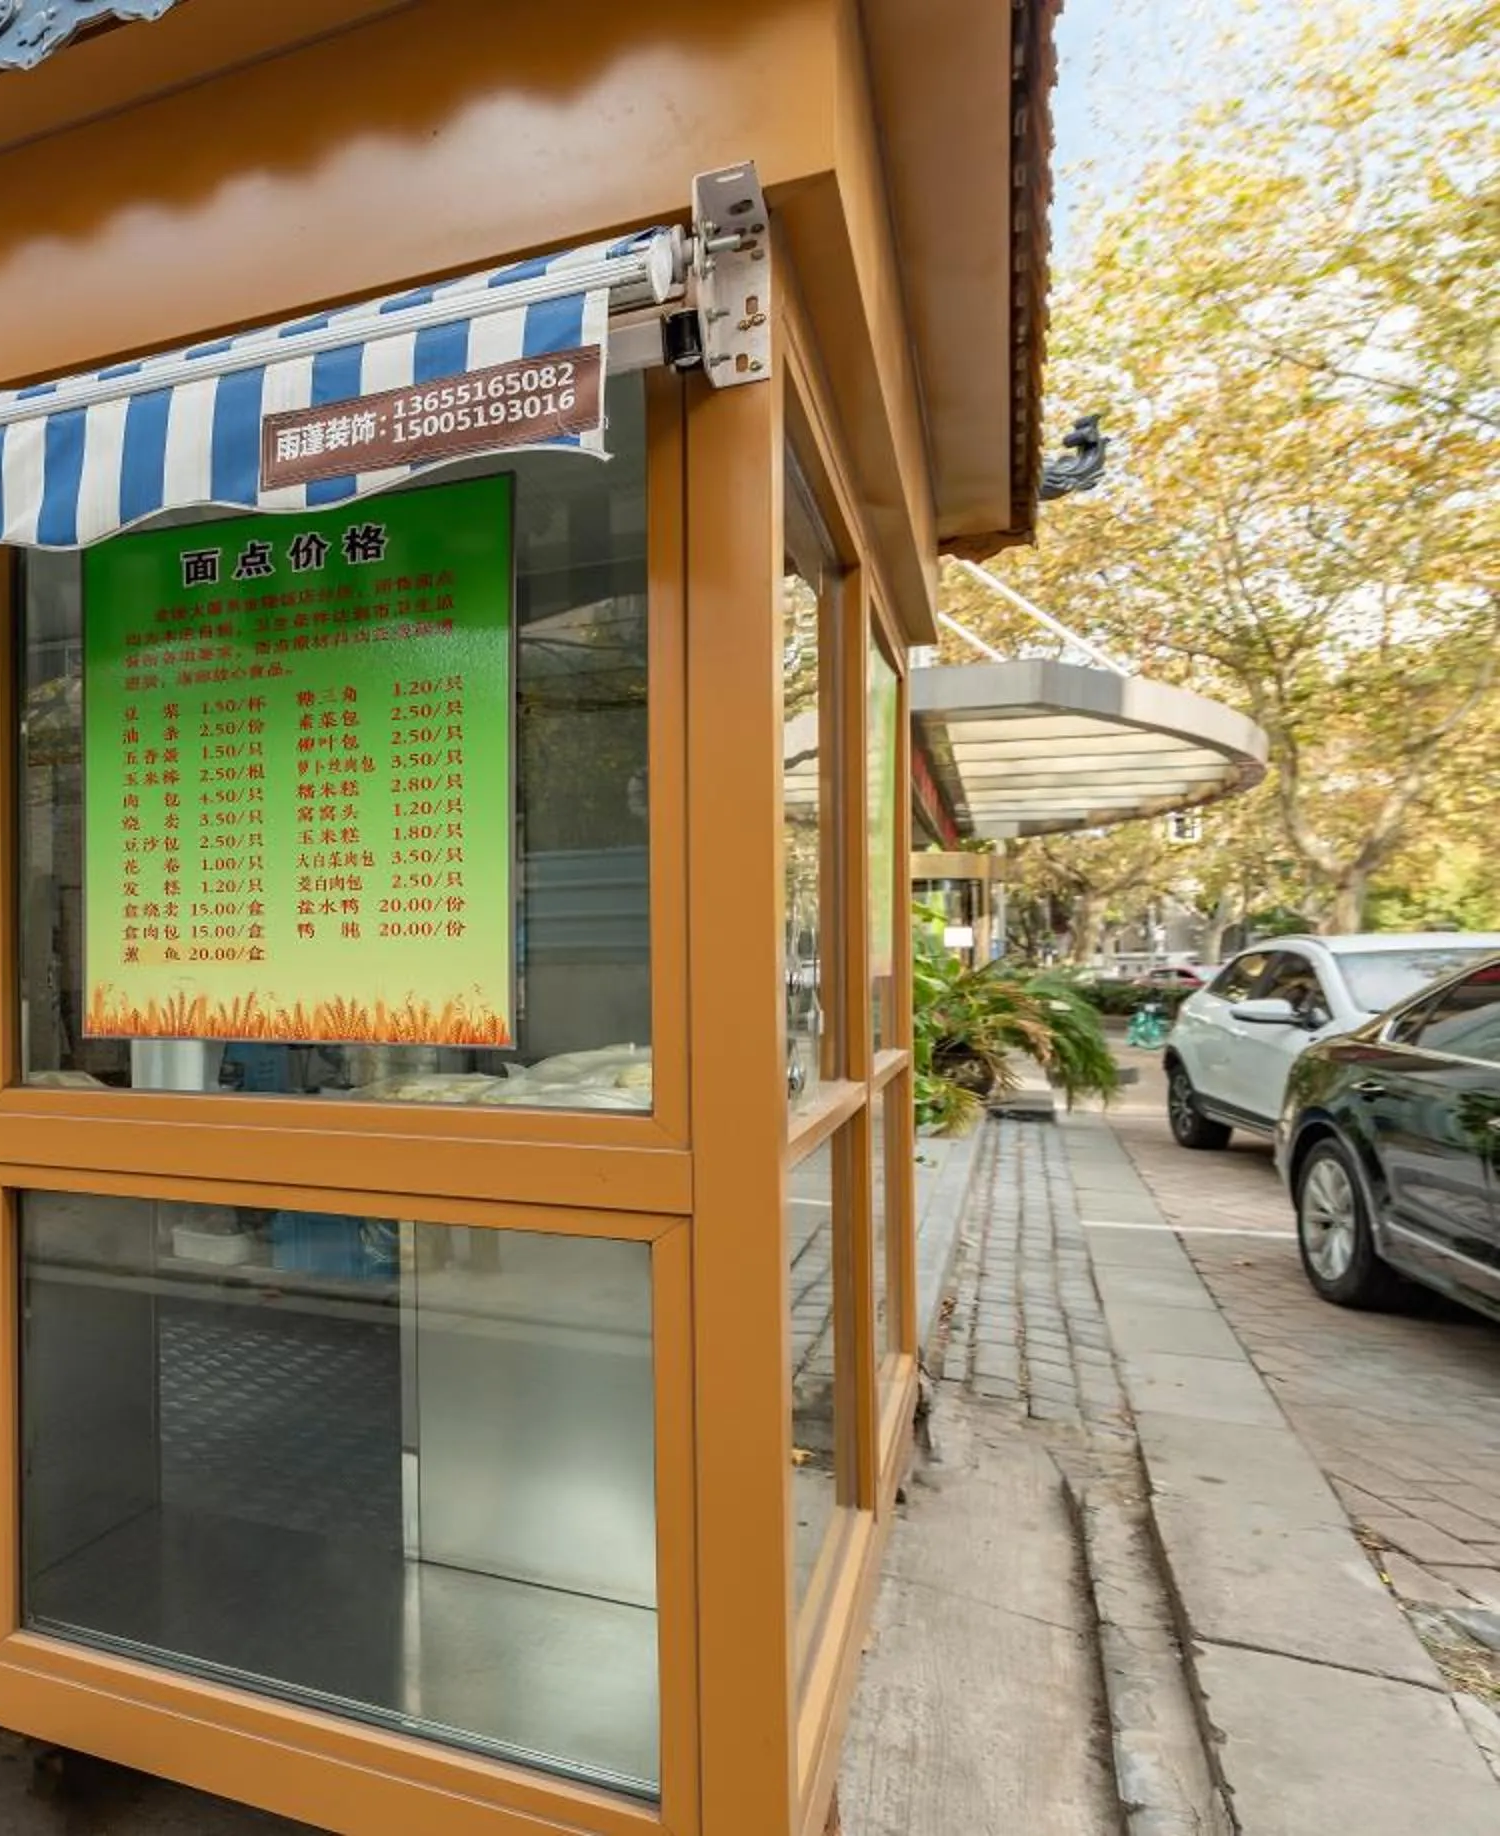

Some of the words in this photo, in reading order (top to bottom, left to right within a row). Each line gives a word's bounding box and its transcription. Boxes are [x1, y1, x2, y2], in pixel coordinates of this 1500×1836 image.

[392, 362, 574, 419] 13655165082
[391, 388, 575, 443] 15005193016
[182, 522, 388, 588] 面点价格
[391, 698, 463, 721] 2.50/只
[391, 724, 463, 746] 2.50/只
[393, 795, 462, 817] 1.20/只
[201, 831, 262, 848] 2.50/只
[201, 853, 262, 871] 1.00/只
[202, 879, 262, 892] 1.20/只
[392, 872, 461, 889] 2.50/只
[380, 895, 466, 913] 20.00/份
[379, 920, 466, 938] 20.00/份
